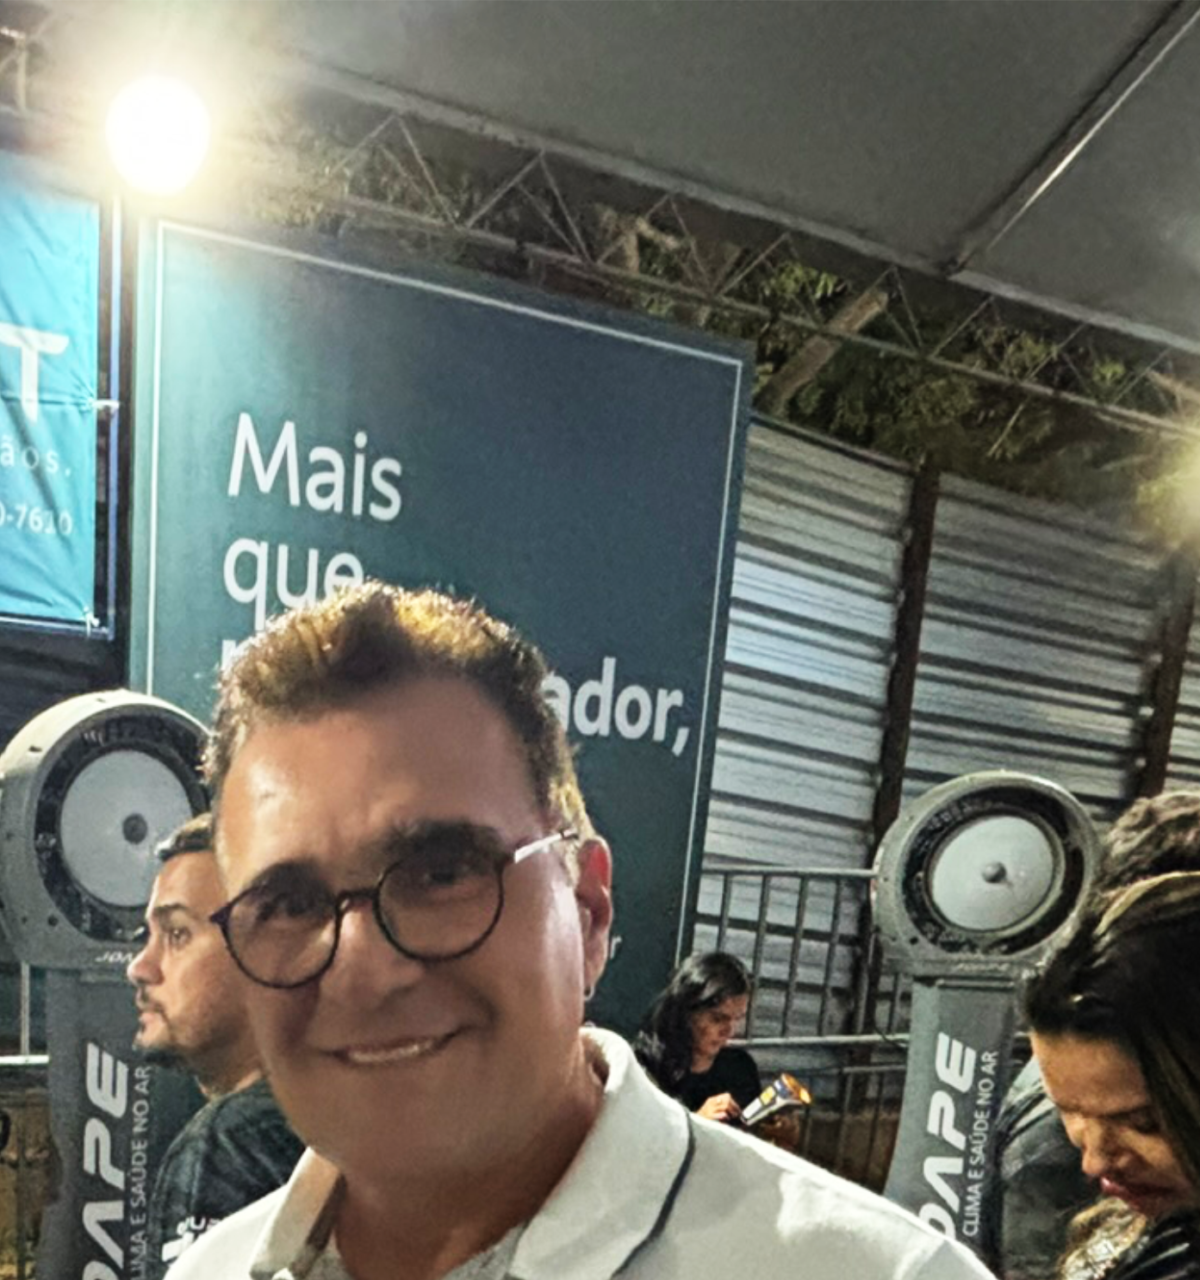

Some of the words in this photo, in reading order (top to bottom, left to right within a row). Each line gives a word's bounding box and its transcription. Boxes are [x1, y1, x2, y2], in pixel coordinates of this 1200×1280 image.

[228, 412, 402, 521] Mais
[223, 537, 364, 631] que
[981, 1051, 999, 1075] AR
[135, 1064, 150, 1101] AR
[976, 1079, 996, 1106] NO
[132, 1104, 149, 1134] NO
[968, 1109, 991, 1166] SAÚDE
[129, 1138, 148, 1206] SAÚDE
[968, 1168, 984, 1180] E
[130, 1212, 146, 1228] E
[963, 1183, 983, 1237] CLIMA
